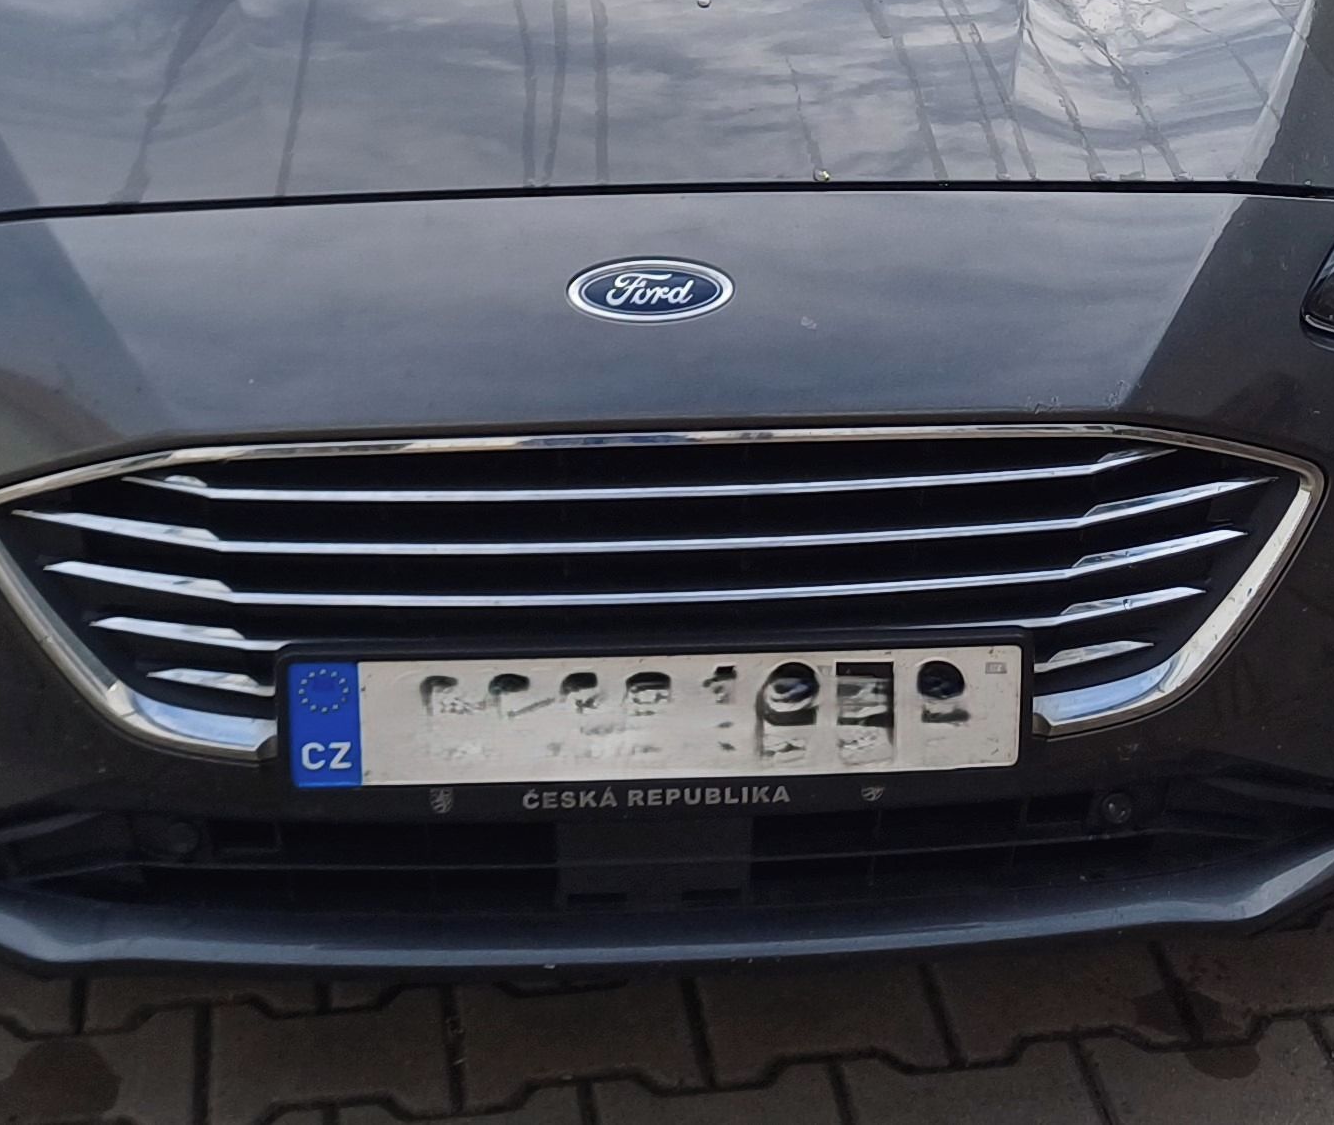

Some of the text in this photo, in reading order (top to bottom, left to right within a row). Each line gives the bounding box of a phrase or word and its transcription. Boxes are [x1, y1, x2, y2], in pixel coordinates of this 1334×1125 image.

[605, 272, 695, 307] Ford
[301, 741, 353, 771] CZ
[522, 785, 791, 811] ČESKÁ REPUBLIKA
